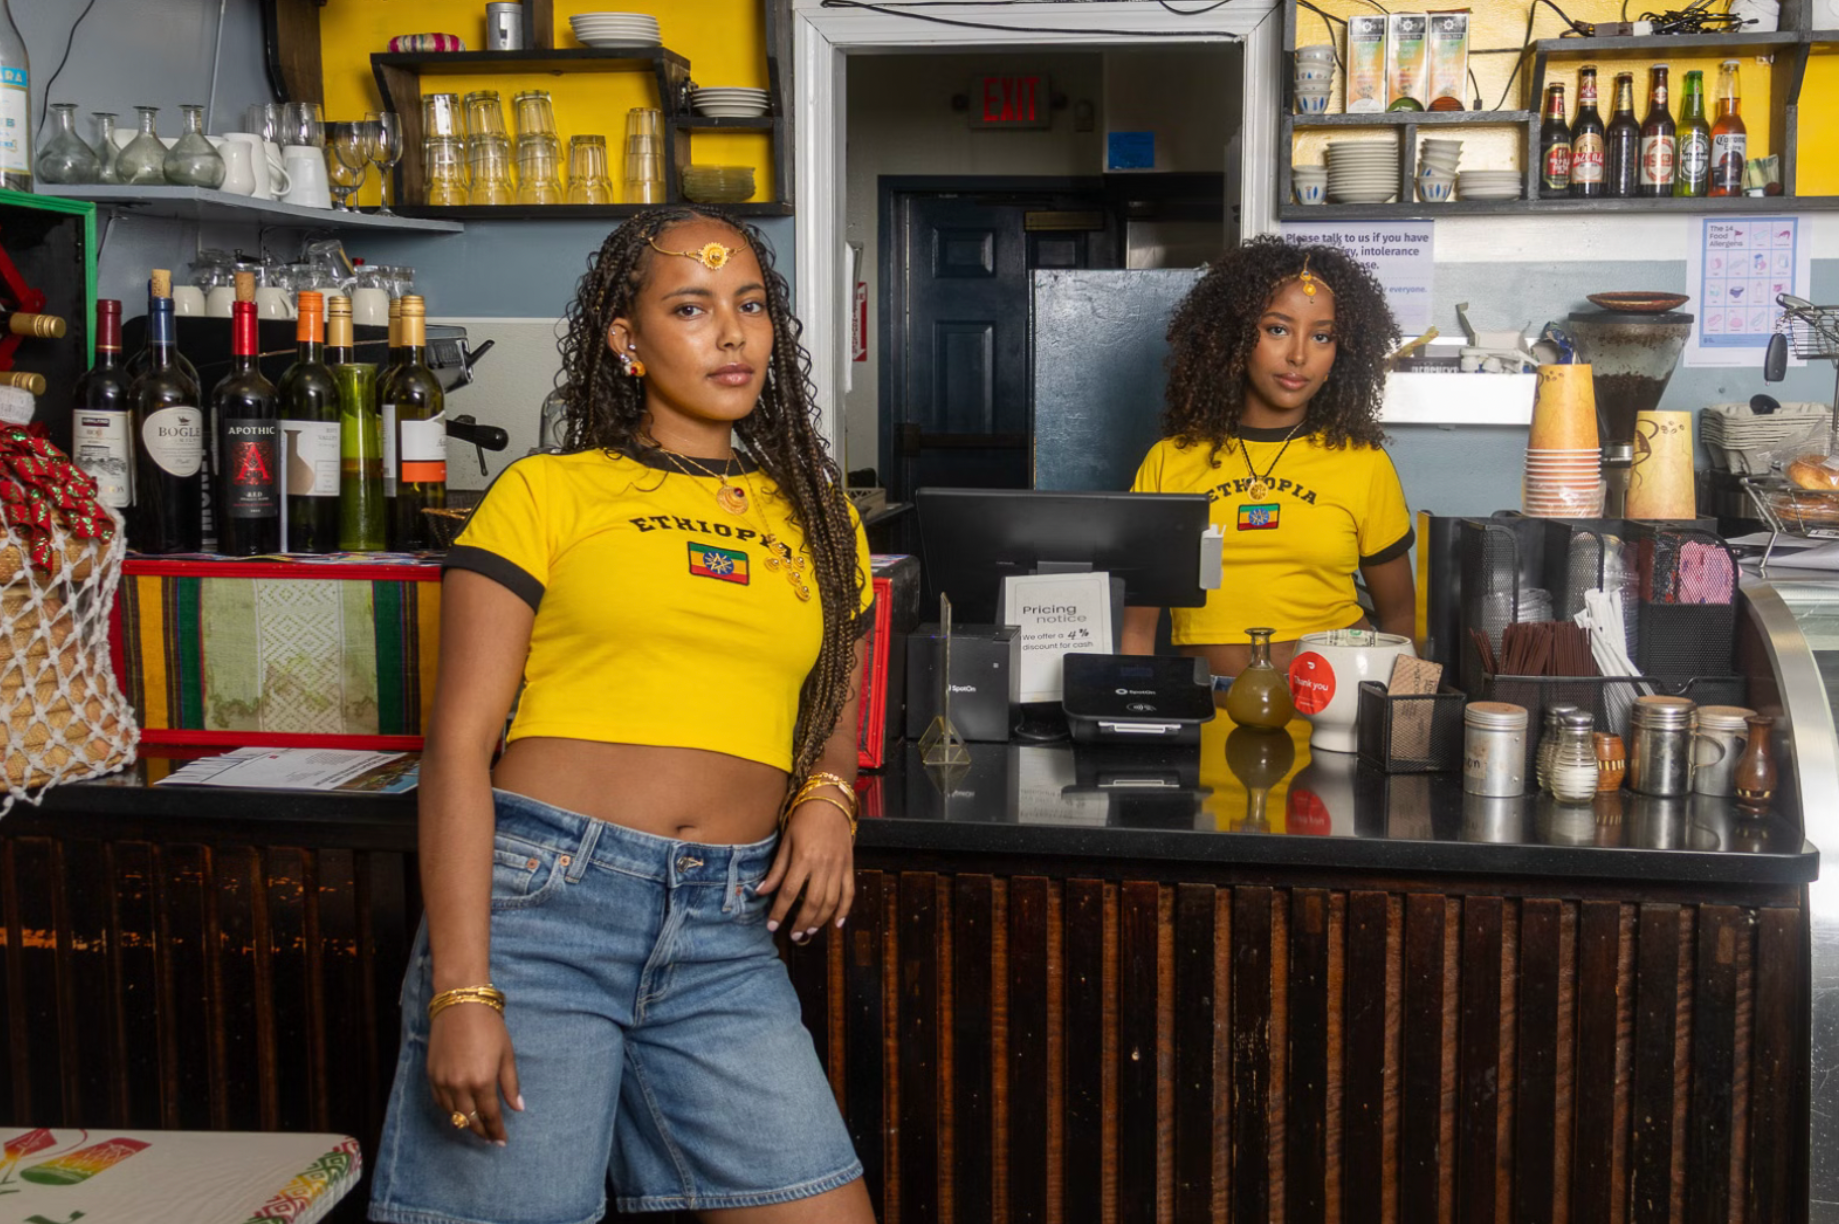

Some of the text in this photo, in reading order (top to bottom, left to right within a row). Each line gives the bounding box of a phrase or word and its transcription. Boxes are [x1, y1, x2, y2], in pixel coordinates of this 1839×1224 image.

[983, 77, 1040, 121] EXIT
[1322, 233, 1342, 243] talk
[1344, 234, 1356, 243] to
[1358, 235, 1370, 243] us
[1372, 232, 1380, 242] if
[1382, 235, 1401, 245] you
[1404, 232, 1429, 243] have
[1709, 240, 1743, 248] Allergens
[1361, 246, 1420, 256] intolerance
[1389, 286, 1427, 294] everyone.
[158, 426, 202, 437] BOGLE
[228, 426, 276, 435] APOTHIC
[1206, 477, 1317, 505] ETHOPIA
[1022, 604, 1077, 615] Pricing
[1036, 614, 1087, 624] notice
[1022, 641, 1094, 651] discount for cash
[952, 684, 976, 693] SpotOn
[1294, 675, 1329, 692] Thank you
